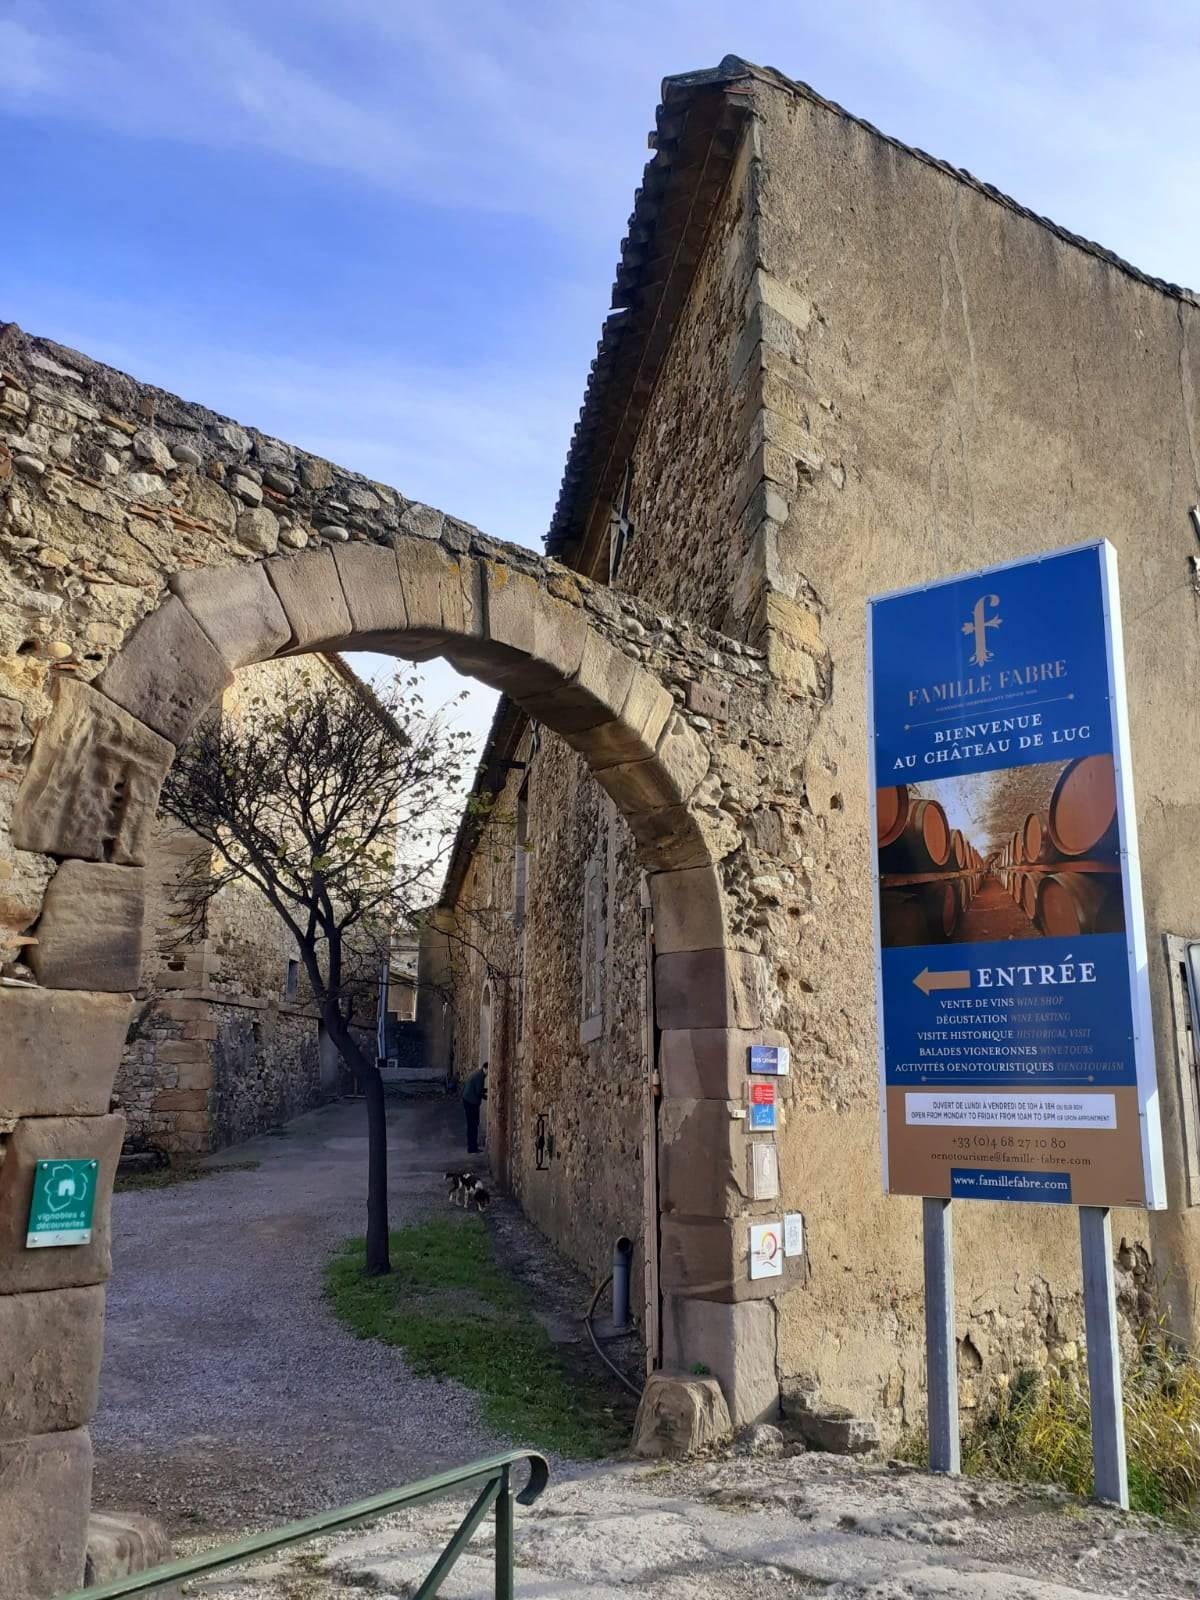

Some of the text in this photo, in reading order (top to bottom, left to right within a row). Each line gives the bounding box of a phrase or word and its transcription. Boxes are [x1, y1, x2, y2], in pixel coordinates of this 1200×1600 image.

[907, 674, 992, 707] FAMILLE
[999, 660, 1068, 688] FABRE
[935, 714, 1042, 743] BIENVENUE
[893, 726, 1090, 770] AU CHÂTEAU DE LUC
[977, 954, 1097, 988] ENTRÉE
[940, 1000, 975, 1009] VENTE
[976, 999, 988, 1008] DE
[990, 998, 1014, 1007] VINS
[936, 1014, 1008, 1025] DÉGUSTATION
[1035, 1012, 1071, 1022] TASTING
[917, 1029, 1091, 1041] VISITE HISTORIQUE HISTORICAL VISIT
[919, 1047, 961, 1056] BALADES
[963, 1046, 1038, 1056] VIGNERONNES
[1065, 1045, 1094, 1055] TOURS
[895, 1062, 1124, 1074] ACTIVITÉS OENOTOURISTIQUES OENOTOURISM
[988, 1102, 1017, 1110] VENDREDI
[1018, 1102, 1026, 1110] DE
[1027, 1102, 1038, 1110] 10H
[968, 1112, 976, 1120] TO
[977, 1112, 998, 1120] FRIDAY
[999, 1112, 1016, 1120] FROM
[1017, 1112, 1032, 1120] 10AM
[951, 1135, 1066, 1149] +33 (0)4 68 27 10 80
[931, 1152, 1091, 1165] oenotourisme@famille-fabre.com
[953, 1175, 1069, 1190] www.famillefabre.com
[37, 1211, 78, 1222] vignobles
[36, 1221, 85, 1230] découvertes
